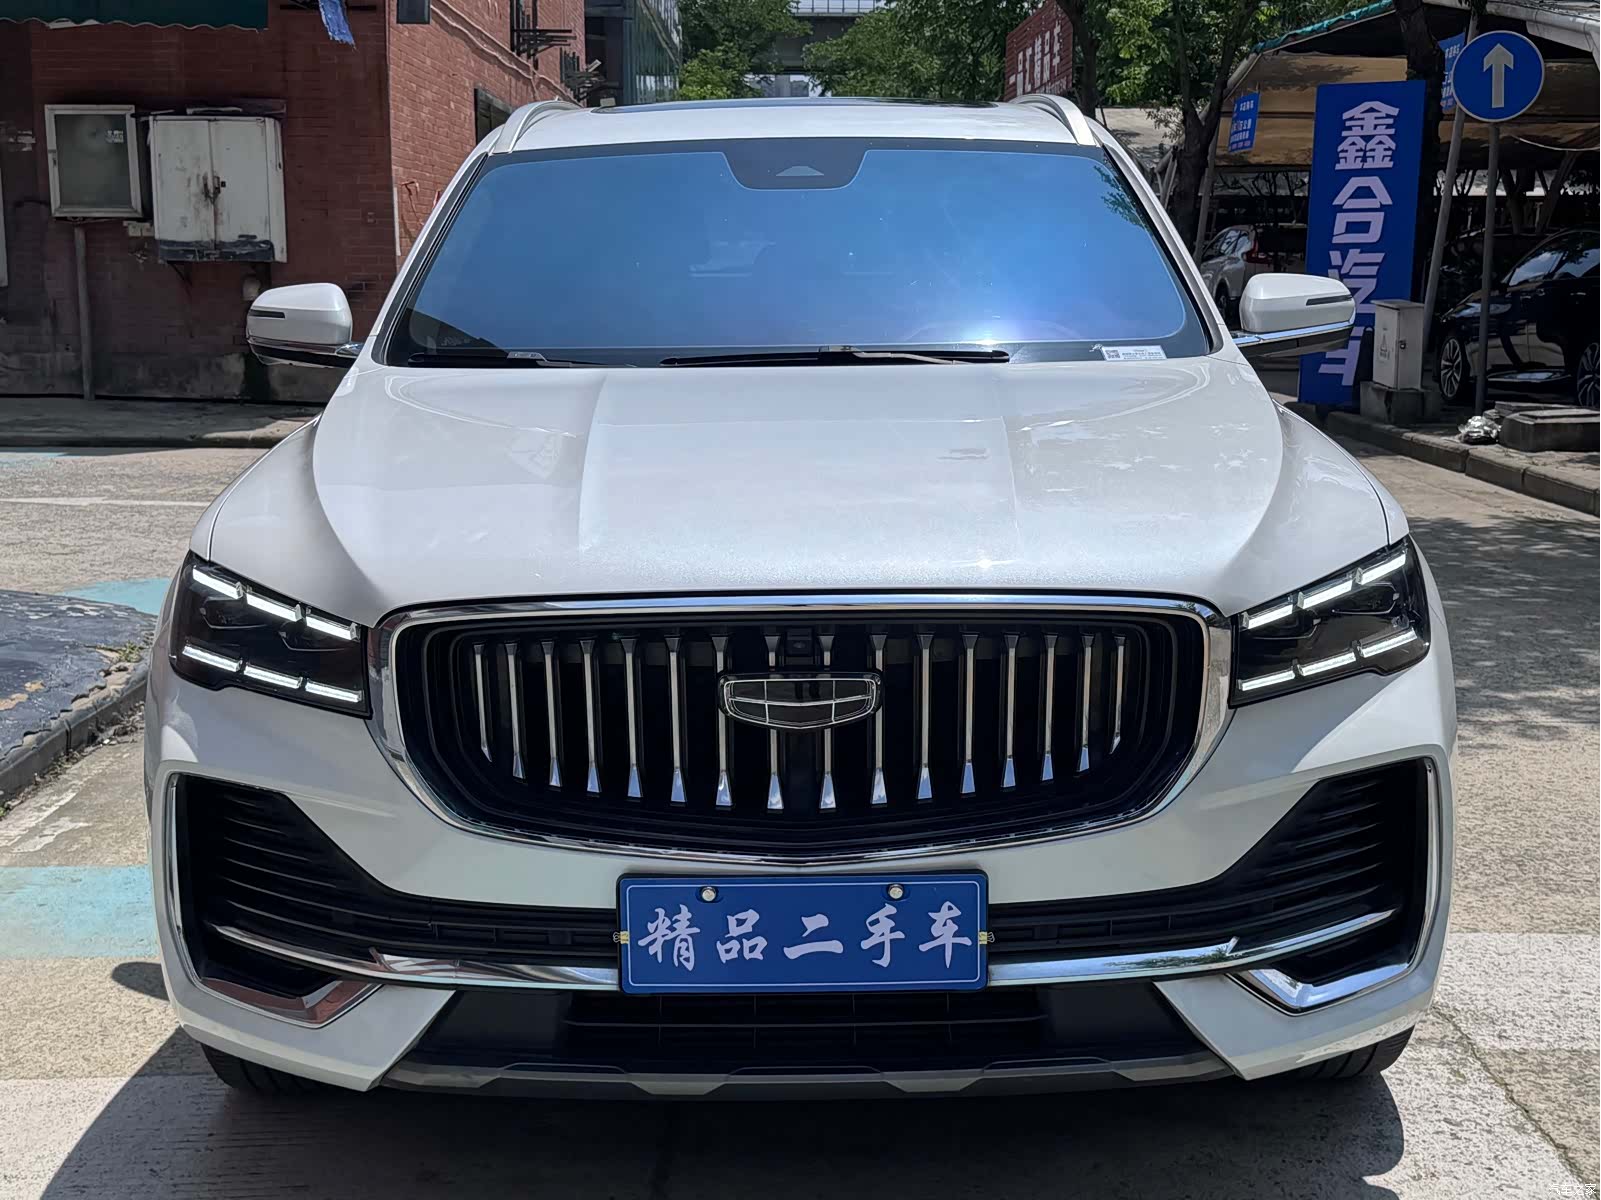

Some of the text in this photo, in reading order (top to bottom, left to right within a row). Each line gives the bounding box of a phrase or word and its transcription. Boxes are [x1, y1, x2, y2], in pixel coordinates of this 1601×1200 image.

[637, 900, 973, 972] 精品二手车
